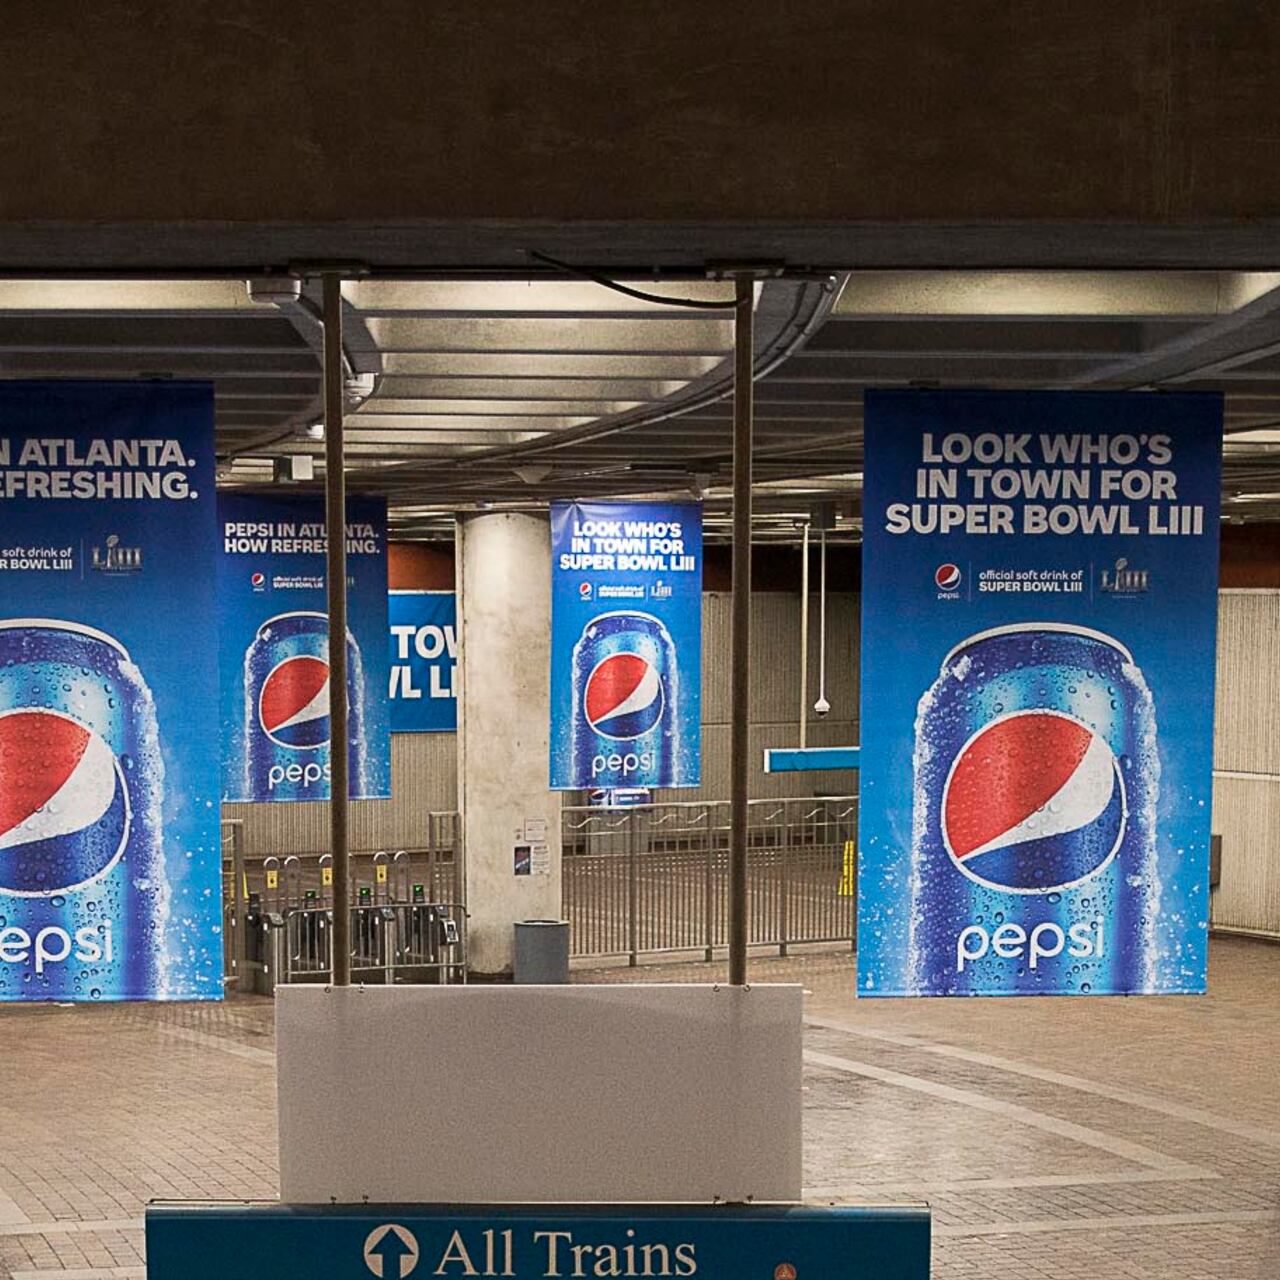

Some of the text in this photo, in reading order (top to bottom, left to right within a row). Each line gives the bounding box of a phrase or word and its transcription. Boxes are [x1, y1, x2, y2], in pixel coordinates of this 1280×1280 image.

[18, 439, 196, 468] ATLANTA.
[922, 432, 1173, 465] LOOK WHO'S
[916, 468, 1178, 500] IN TOWN FOR
[885, 503, 1204, 536] SUPER BOWL LIII
[224, 522, 380, 538] PEPSI IN ATLNTA.
[573, 521, 682, 538] LOOK WHO'S
[2, 546, 25, 558] soft
[27, 547, 58, 558] drink
[60, 547, 72, 558] of
[224, 538, 380, 554] HOW REFRESING.
[571, 538, 684, 555] IN TOWN FOR
[10, 558, 51, 570] BOWL
[53, 558, 73, 570] LIII
[559, 554, 695, 571] SUPER BOWL LIII
[978, 570, 1083, 581] official soft drink of
[978, 581, 1083, 592] SUPER BOWL LIII
[591, 754, 656, 778] pepsi
[955, 916, 1105, 971] pepsi
[433, 1228, 698, 1278] All Trains
